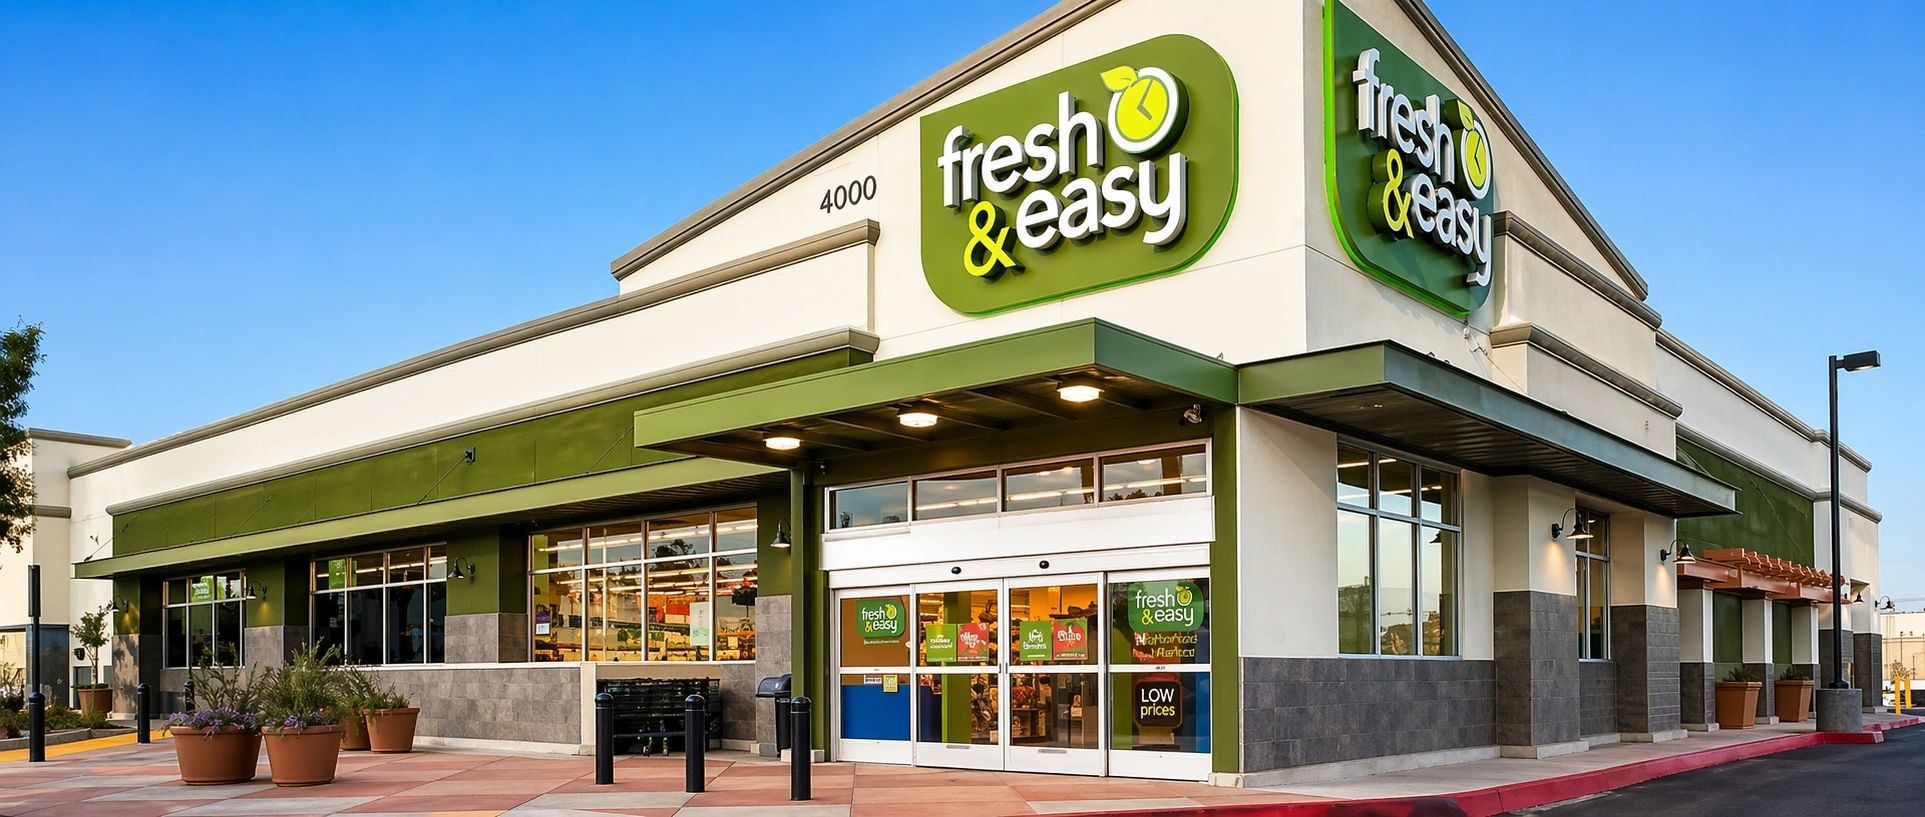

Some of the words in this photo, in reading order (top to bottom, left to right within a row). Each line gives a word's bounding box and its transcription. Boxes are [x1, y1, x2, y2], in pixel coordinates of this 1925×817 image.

[1353, 48, 1455, 185] fresh
[938, 91, 1102, 207] fresh
[820, 175, 877, 214] 4000
[964, 200, 1017, 277] &
[1016, 152, 1187, 249] easy
[1407, 173, 1492, 287] easy
[1135, 587, 1175, 608] fresh
[861, 605, 886, 621] fresh
[1154, 607, 1194, 627] easy
[872, 619, 898, 634] easy
[1141, 688, 1175, 703] LOW
[1140, 702, 1176, 720] prices
